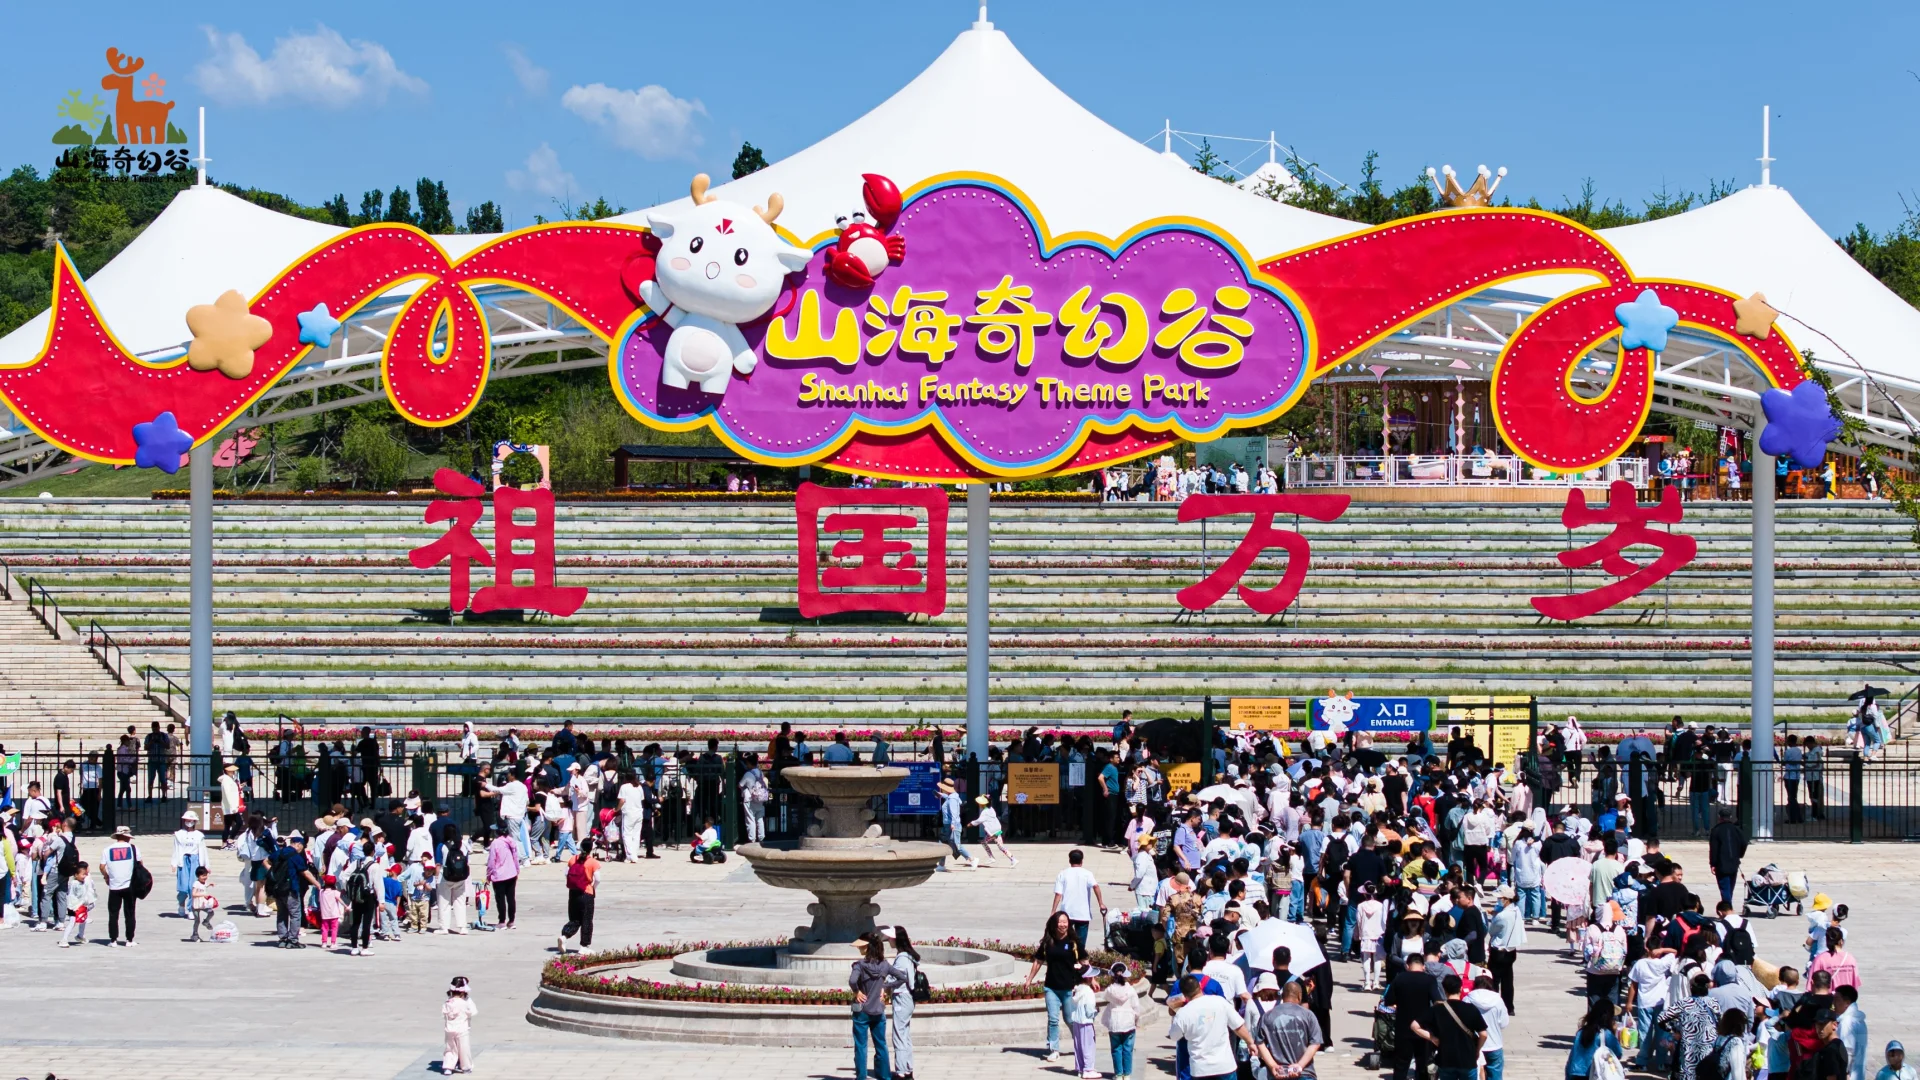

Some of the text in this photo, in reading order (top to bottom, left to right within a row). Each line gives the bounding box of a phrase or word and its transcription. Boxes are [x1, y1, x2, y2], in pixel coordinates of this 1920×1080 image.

[765, 274, 1254, 370] 山海奇幻谷
[799, 373, 1211, 404] Shanhai Fantasy Theme Park
[1377, 702, 1407, 717] 入口
[1370, 719, 1415, 727] ENTRANCE
